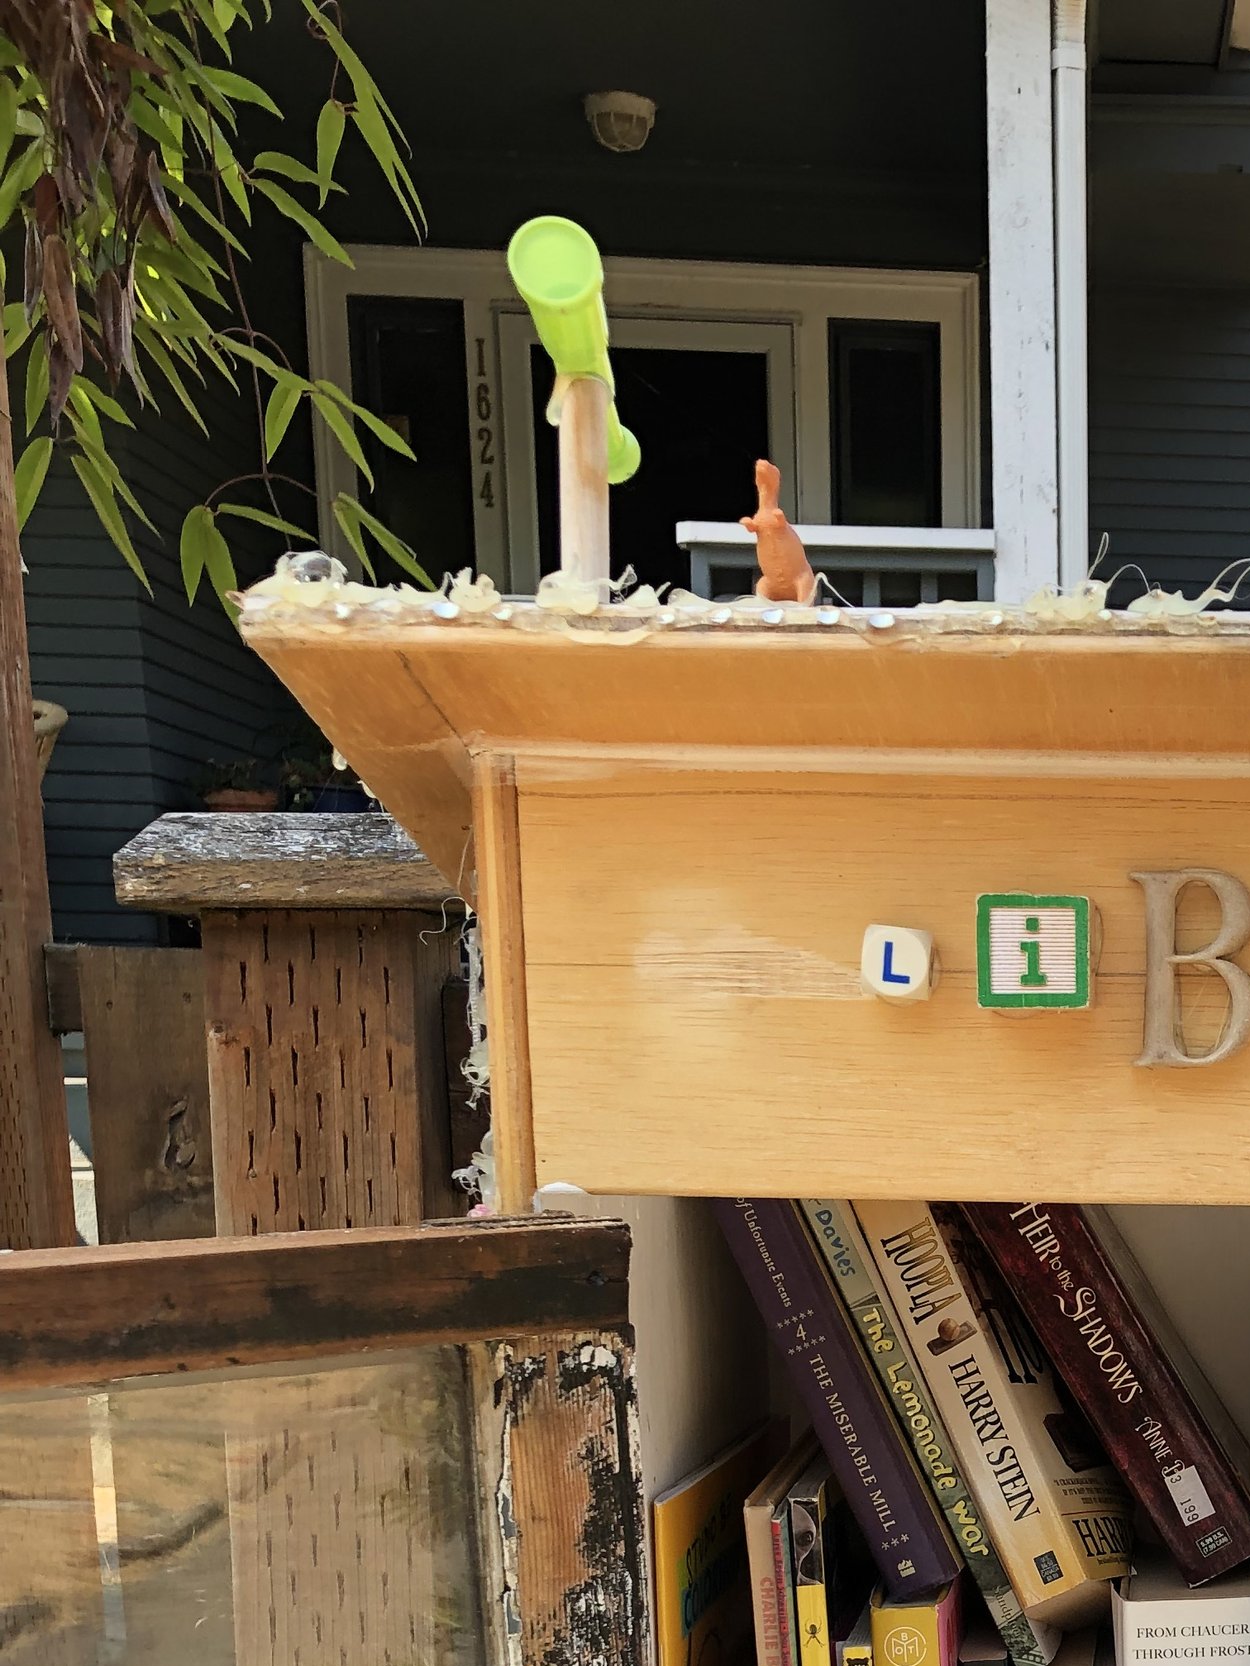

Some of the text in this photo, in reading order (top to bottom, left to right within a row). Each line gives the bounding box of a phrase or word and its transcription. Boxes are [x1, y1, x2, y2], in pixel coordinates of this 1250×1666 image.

[474, 336, 496, 509] 1624
[744, 1210, 776, 1272] Unfortunate
[772, 1272, 792, 1308] Events
[815, 1209, 855, 1277] Davies
[881, 1217, 962, 1325] HOOPLA
[796, 1324, 807, 1341] 4
[1009, 1202, 1143, 1404] HEIR to the SHADOWS
[809, 1354, 897, 1532] THE MISERABLE MILL
[860, 1307, 895, 1355] The
[886, 1361, 958, 1491] Lemonade
[948, 1354, 1040, 1522] HARRY STEIN
[1135, 1418, 1173, 1463] ANNE
[759, 1576, 780, 1651] CHARLIE
[1133, 1648, 1206, 1660] THROUGH
[1136, 1624, 1250, 1638] FROM CHAUCER
